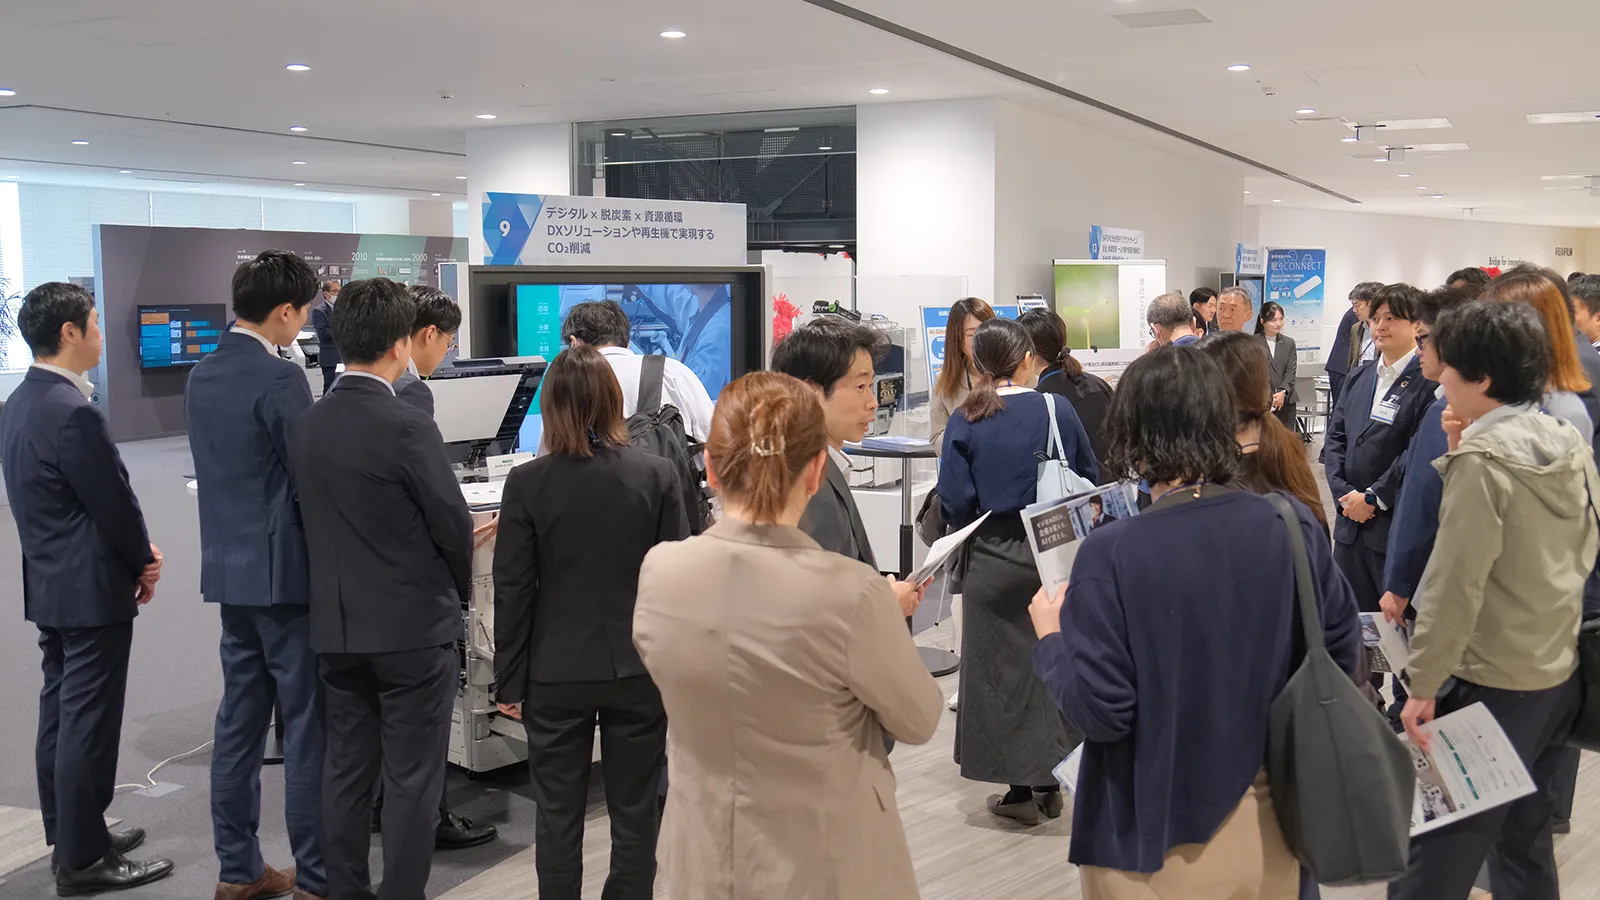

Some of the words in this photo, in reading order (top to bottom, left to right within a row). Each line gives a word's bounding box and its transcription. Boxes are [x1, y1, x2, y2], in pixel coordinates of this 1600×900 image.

[546, 207, 588, 220] デジタル
[600, 209, 632, 221] 脱炭素
[644, 210, 683, 223] 資源循環
[499, 220, 511, 237] 9
[547, 225, 715, 240] DXソリューションや再生機で実現する
[351, 252, 368, 261] 2010
[412, 253, 428, 262] 2000
[1555, 247, 1573, 256] FUJIFILM
